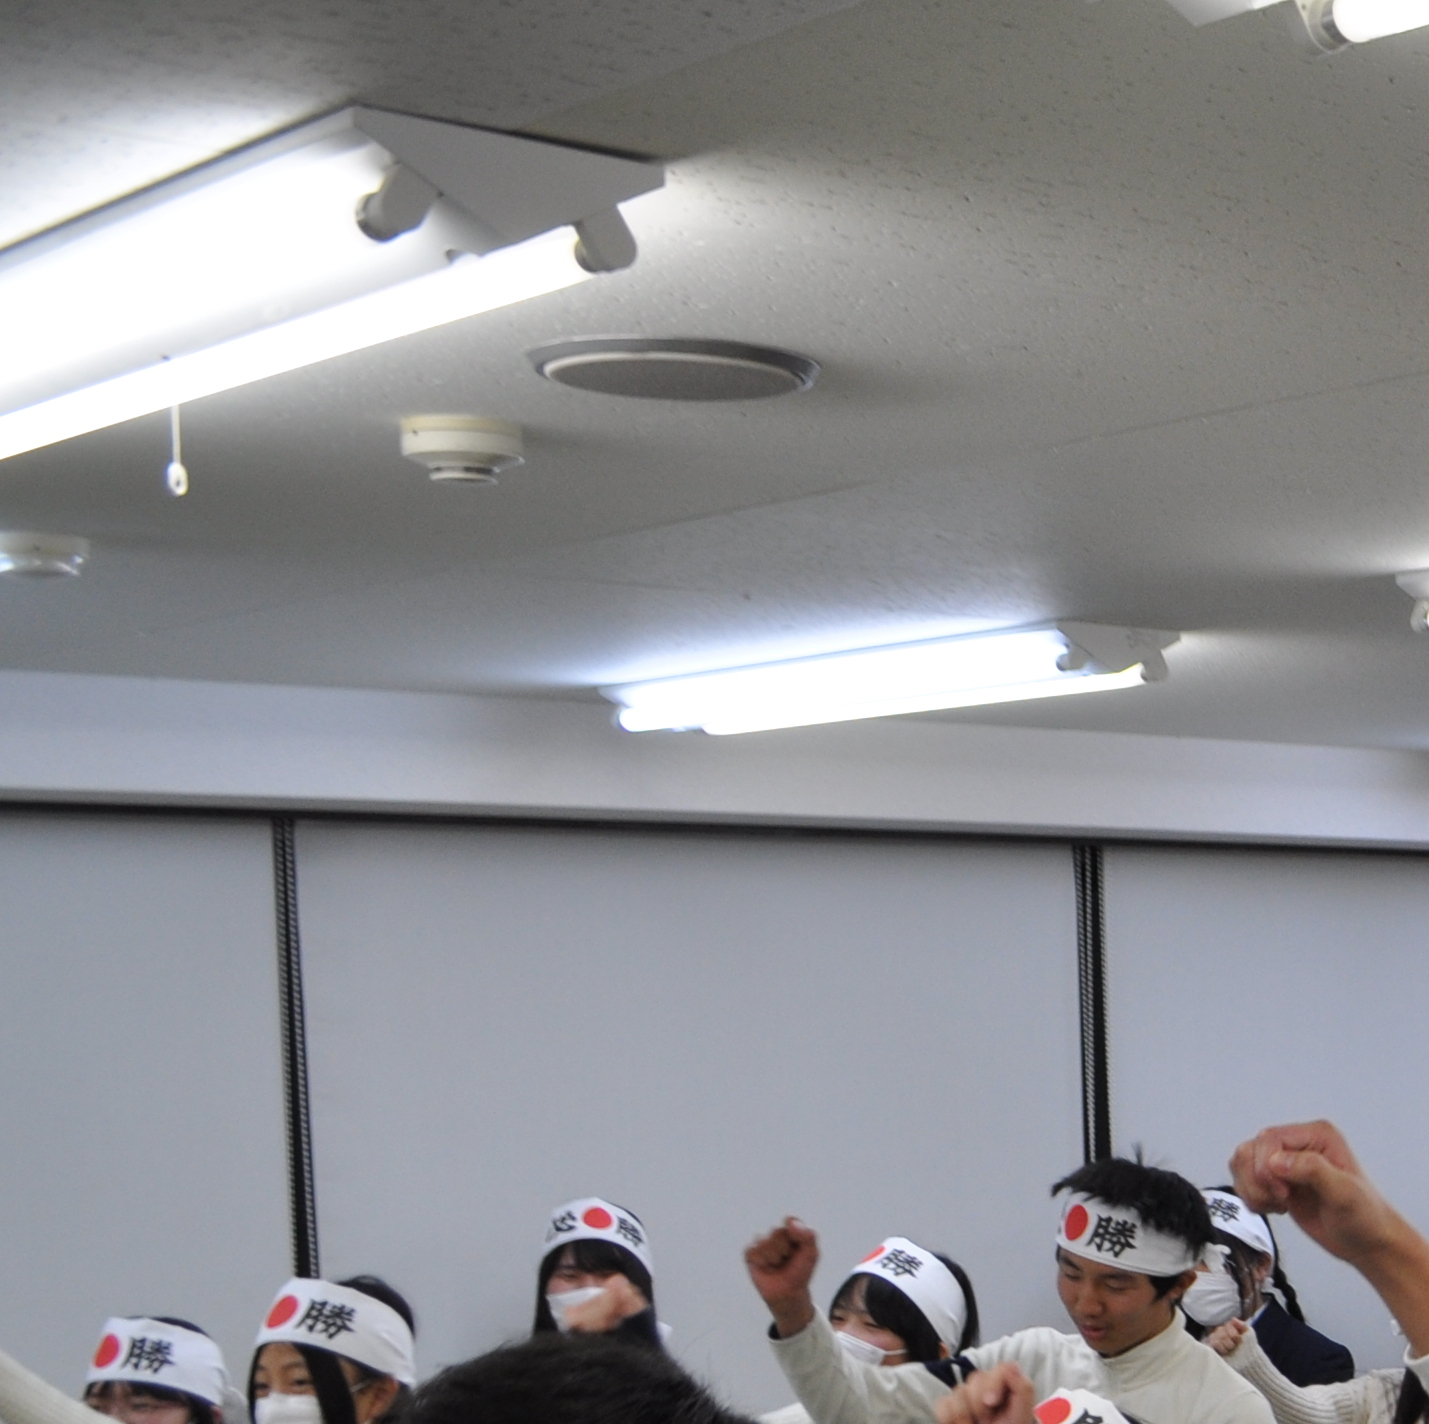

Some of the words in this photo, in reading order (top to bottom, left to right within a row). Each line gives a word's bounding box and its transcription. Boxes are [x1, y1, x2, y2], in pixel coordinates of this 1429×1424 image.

[1207, 1197, 1242, 1224] 勝
[1085, 1213, 1139, 1259] 勝
[875, 1247, 924, 1280] 勝
[295, 1298, 357, 1340] 勝
[121, 1335, 176, 1374] 勝
